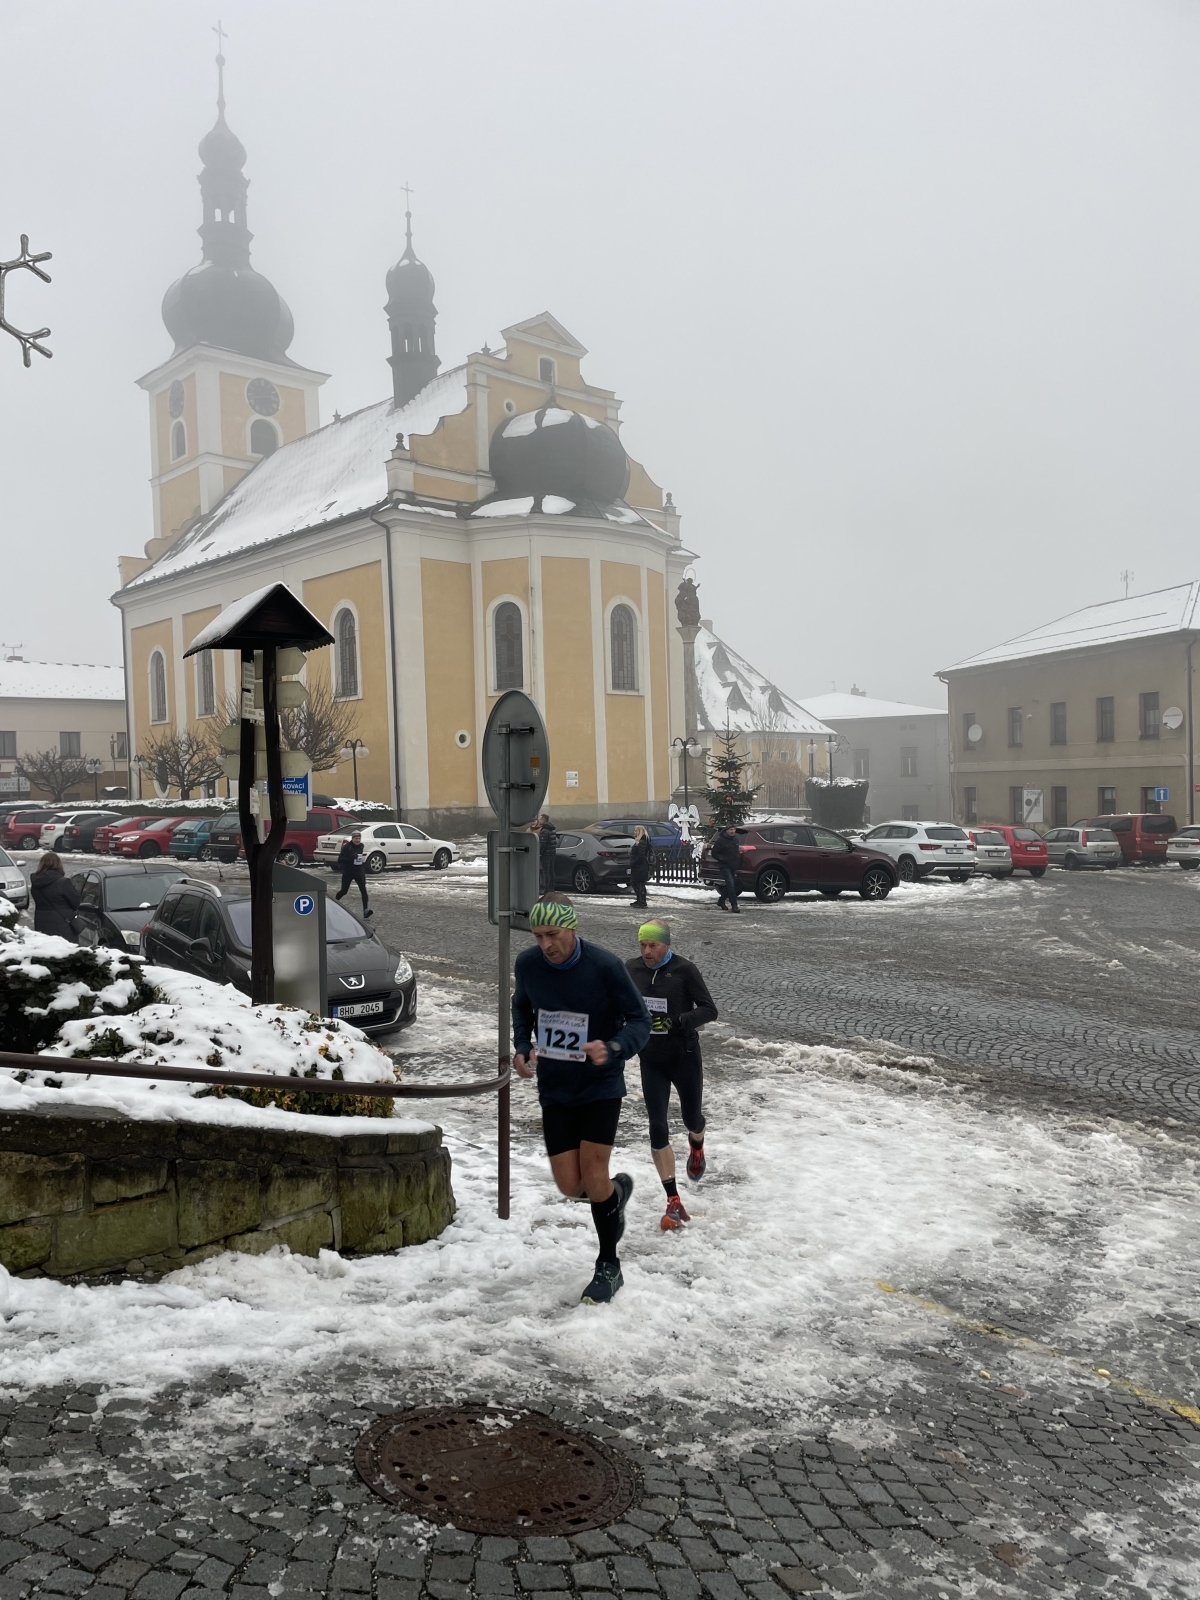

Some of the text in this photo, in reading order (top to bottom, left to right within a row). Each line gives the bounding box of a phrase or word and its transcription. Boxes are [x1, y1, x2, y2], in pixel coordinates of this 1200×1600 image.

[299, 898, 309, 912] P
[360, 1002, 380, 1014] 2045
[545, 1027, 581, 1051] 122
